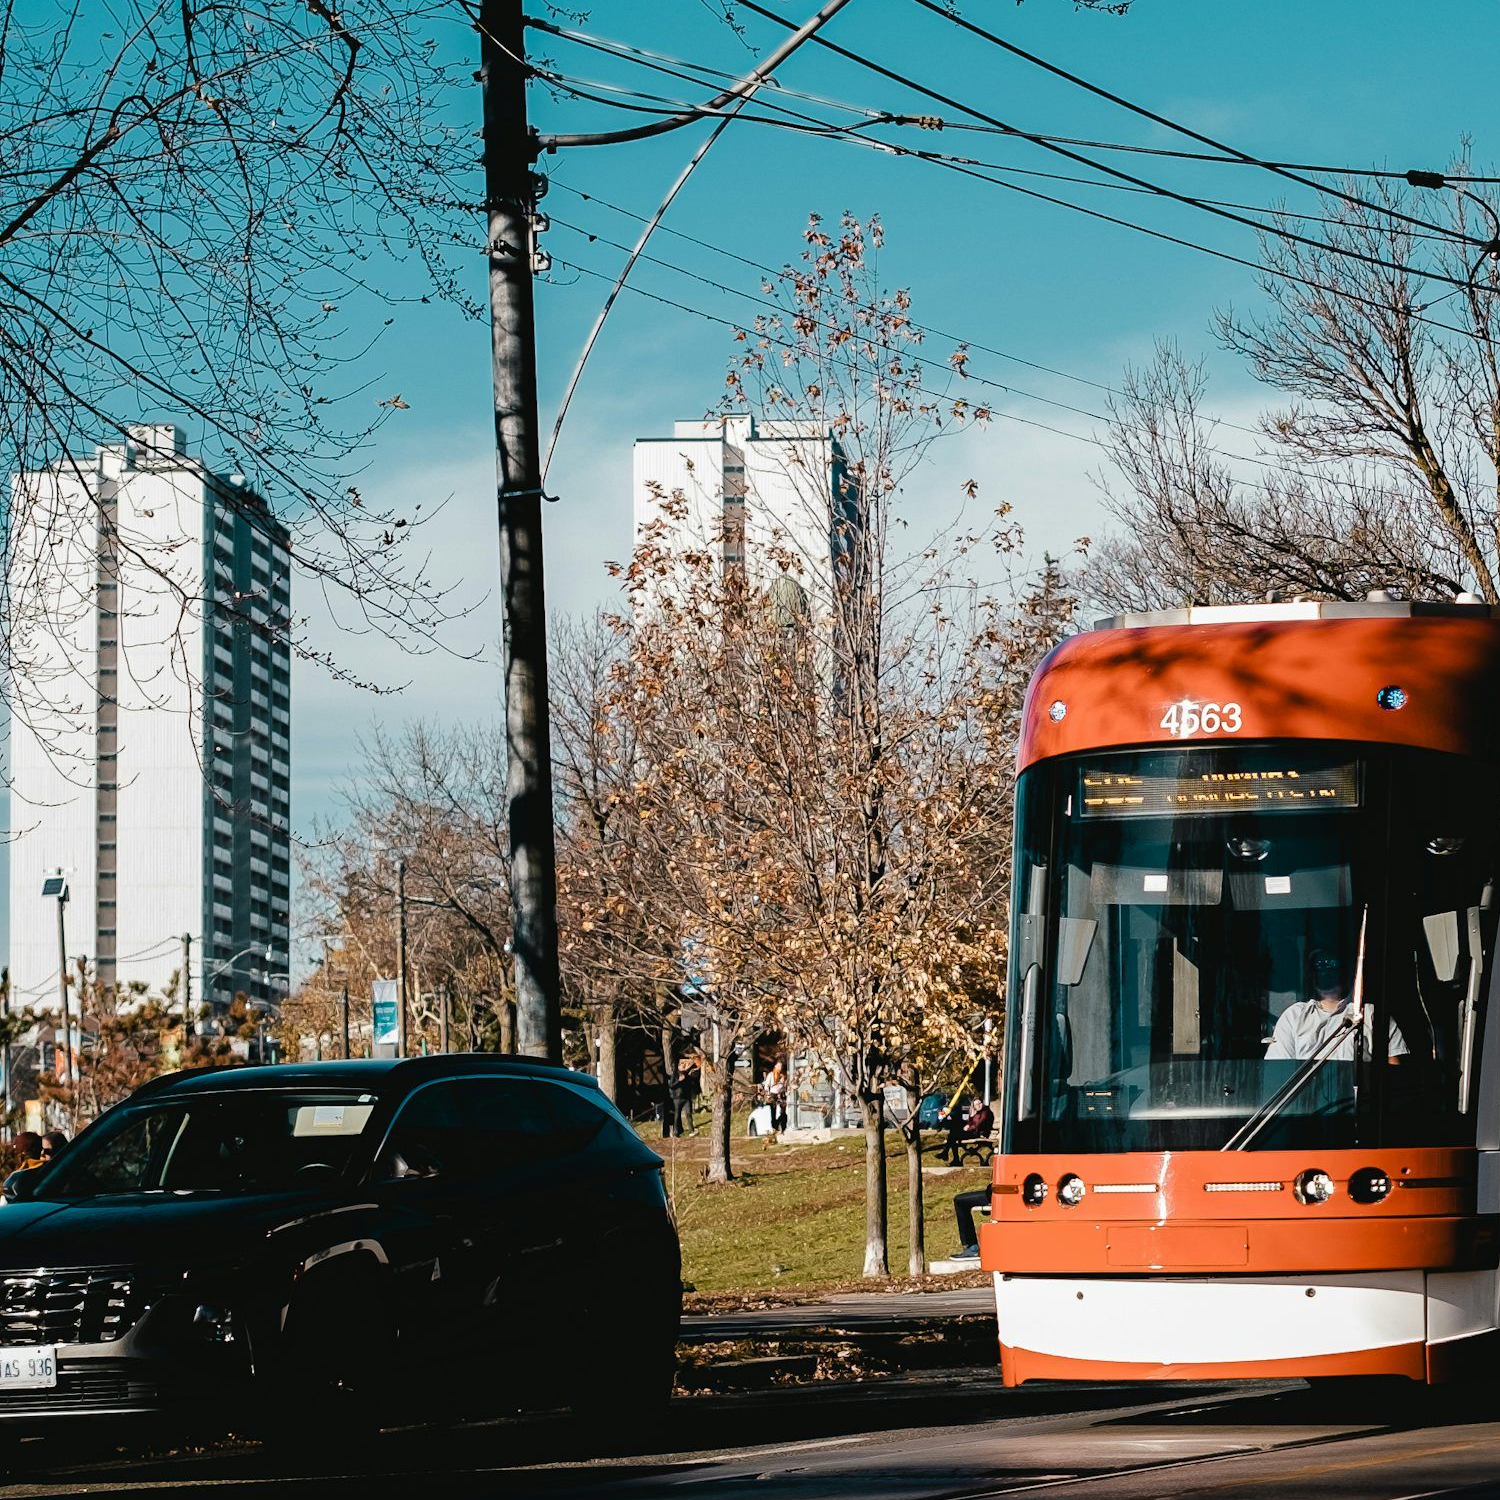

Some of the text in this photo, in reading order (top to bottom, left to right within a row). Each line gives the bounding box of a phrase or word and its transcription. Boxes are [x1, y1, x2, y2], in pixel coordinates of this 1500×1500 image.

[1160, 703, 1242, 735] 4563
[0, 1358, 52, 1377] AS 936
